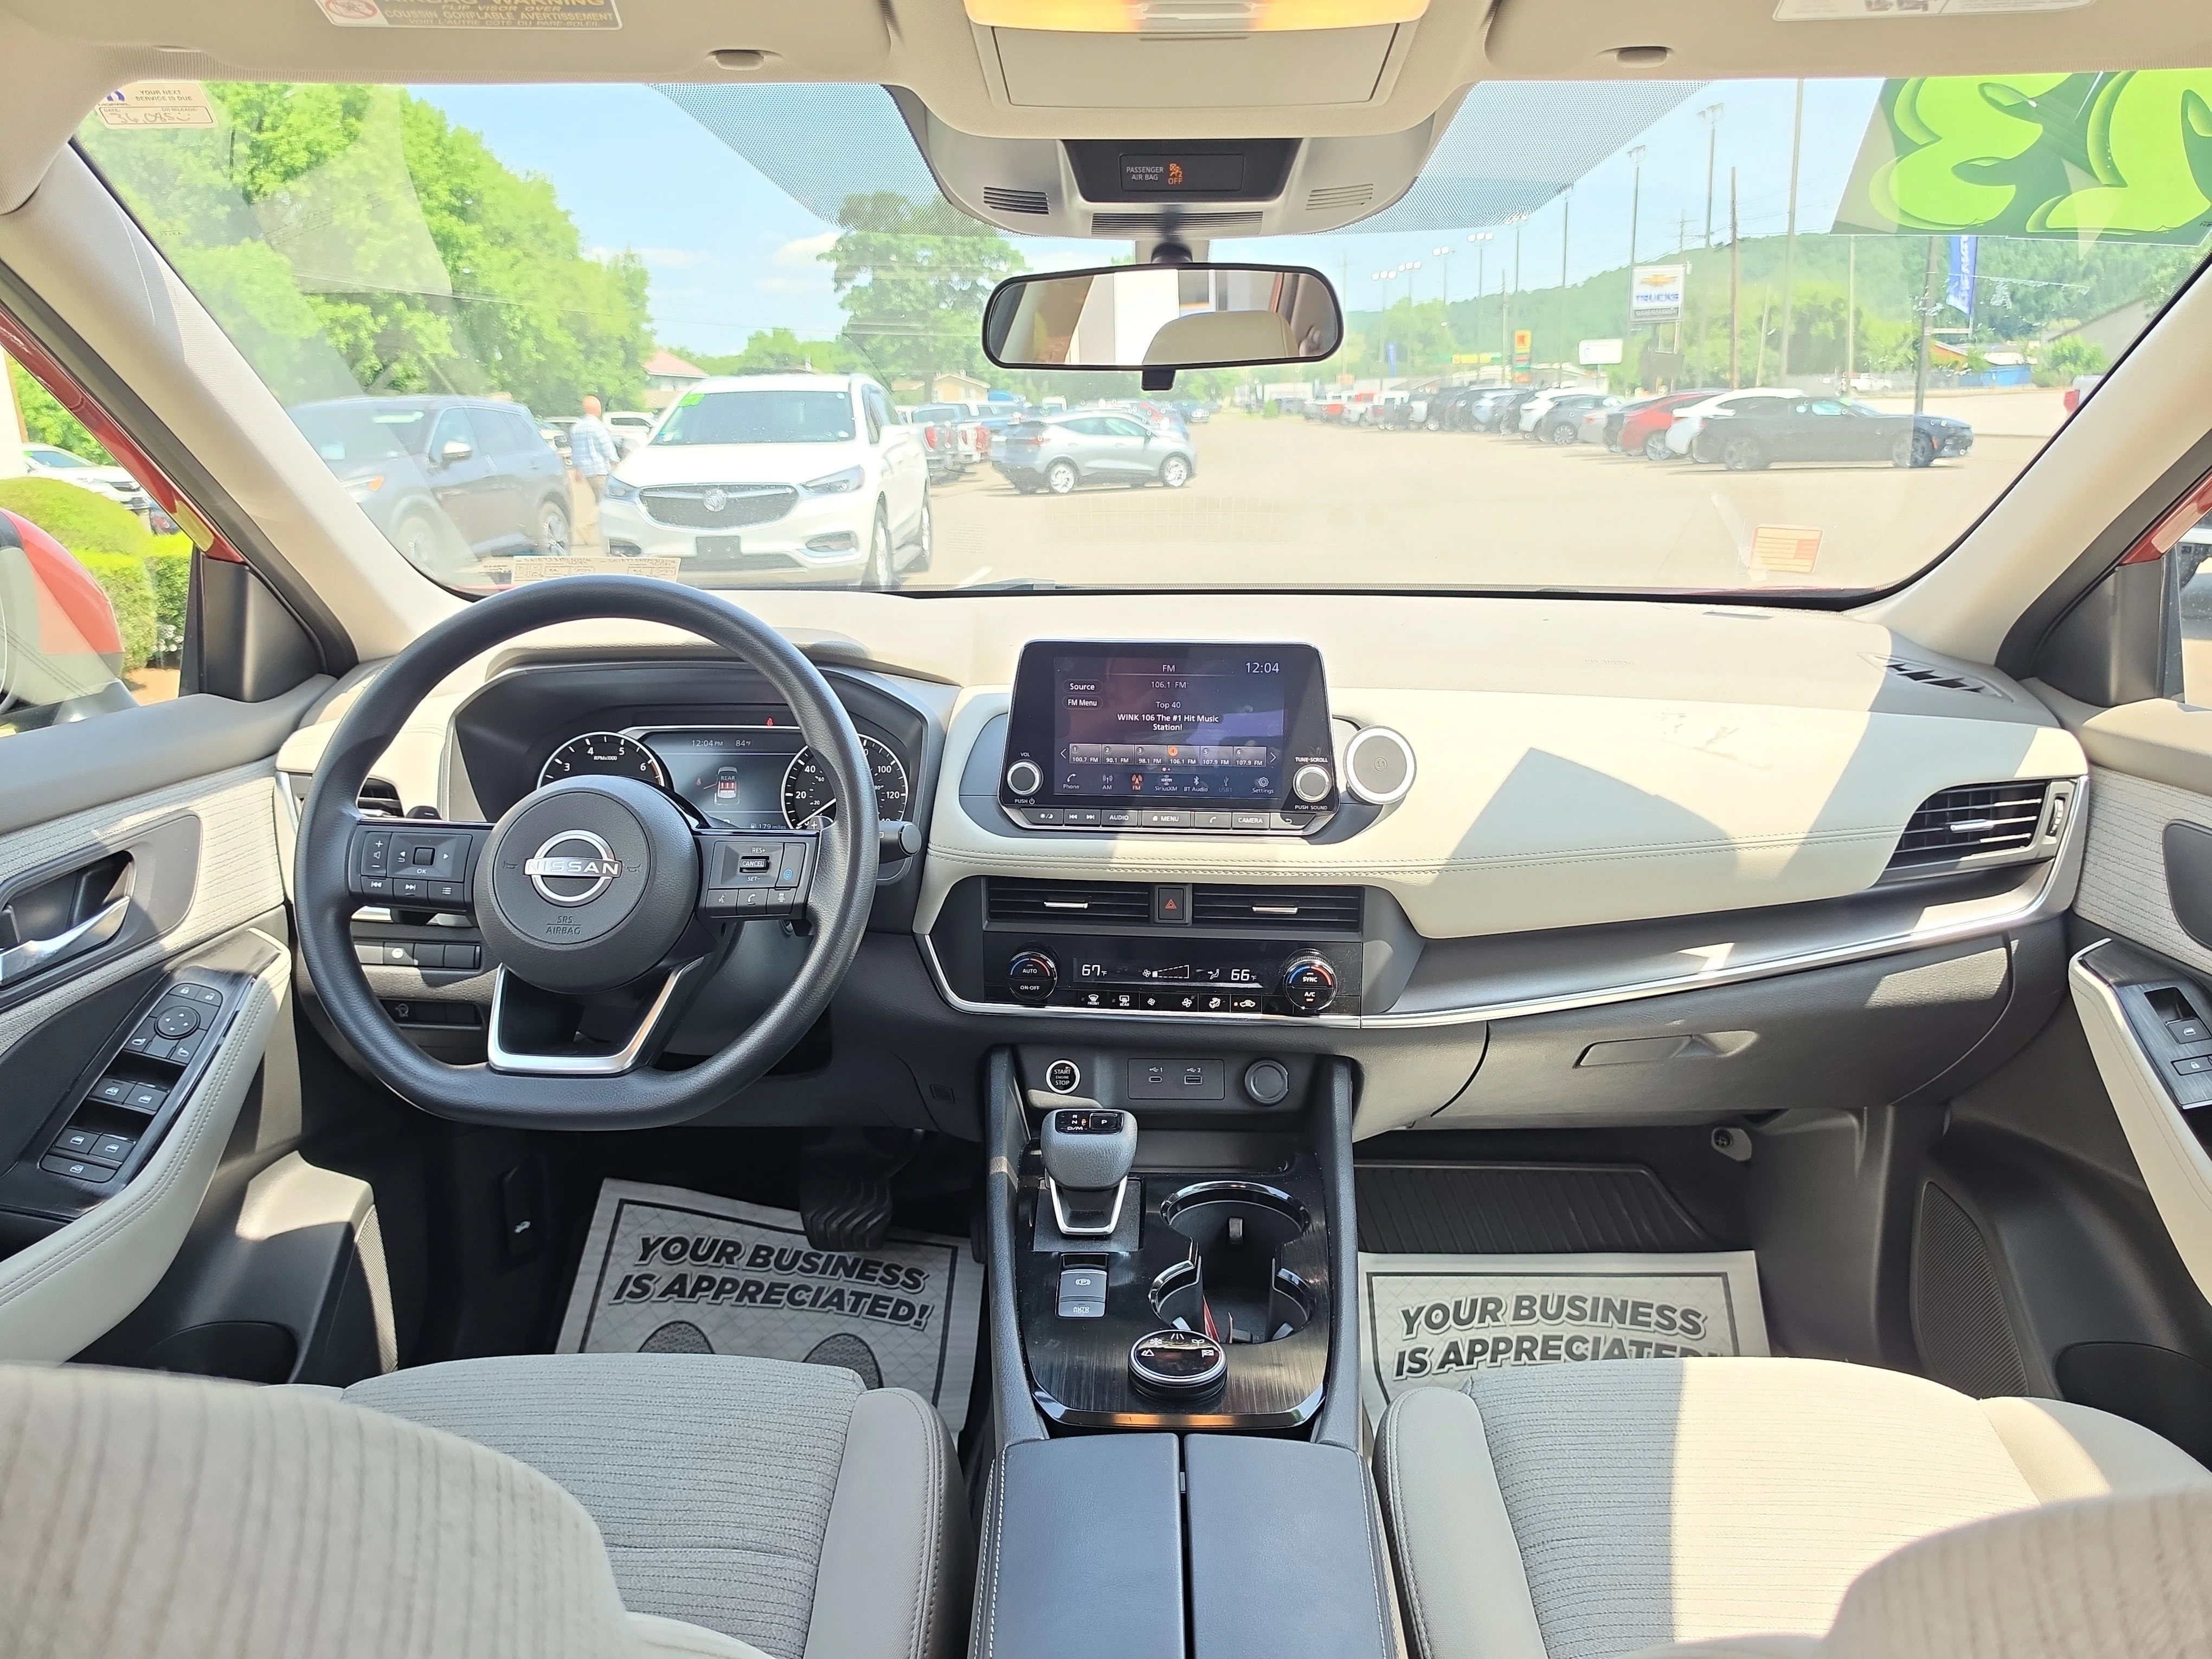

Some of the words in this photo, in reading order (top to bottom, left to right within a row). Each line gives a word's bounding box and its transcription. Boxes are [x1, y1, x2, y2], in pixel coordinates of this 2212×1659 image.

[384, 10, 438, 18] COUSSIN
[442, 11, 516, 20] GONFLABLE
[520, 12, 613, 21] AVERTISSEMENT
[1162, 664, 1175, 673] FM
[1245, 662, 1280, 674] 12:04
[1070, 683, 1095, 691] Source
[1150, 681, 1171, 689] 106.1
[1175, 681, 1187, 689] FM
[1068, 699, 1078, 707] FM
[1079, 699, 1097, 707] Menu
[1155, 701, 1169, 710] Top
[1117, 713, 1140, 722] WINK
[1141, 713, 1155, 722] 106
[1172, 714, 1182, 722] #1
[1184, 714, 1195, 722] Hit
[1153, 723, 1182, 731] Station!
[587, 747, 594, 755] 4
[619, 747, 625, 756] 5
[563, 762, 570, 771] 3
[640, 762, 647, 771] 6
[804, 765, 816, 773] 40
[877, 765, 892, 773] 100
[795, 791, 807, 799] 20
[886, 791, 900, 799] 120
[528, 860, 619, 875] NISSAN
[545, 926, 581, 935] AIRBAG
[636, 1236, 745, 1266] YOUR
[746, 1244, 929, 1291] BUSINESS
[614, 1274, 660, 1302] IS
[658, 1272, 935, 1328] APPRECIATED!
[1401, 1297, 1506, 1336] YOUR
[1512, 1293, 1708, 1337] BUSINESS
[1395, 1346, 1432, 1377] IS
